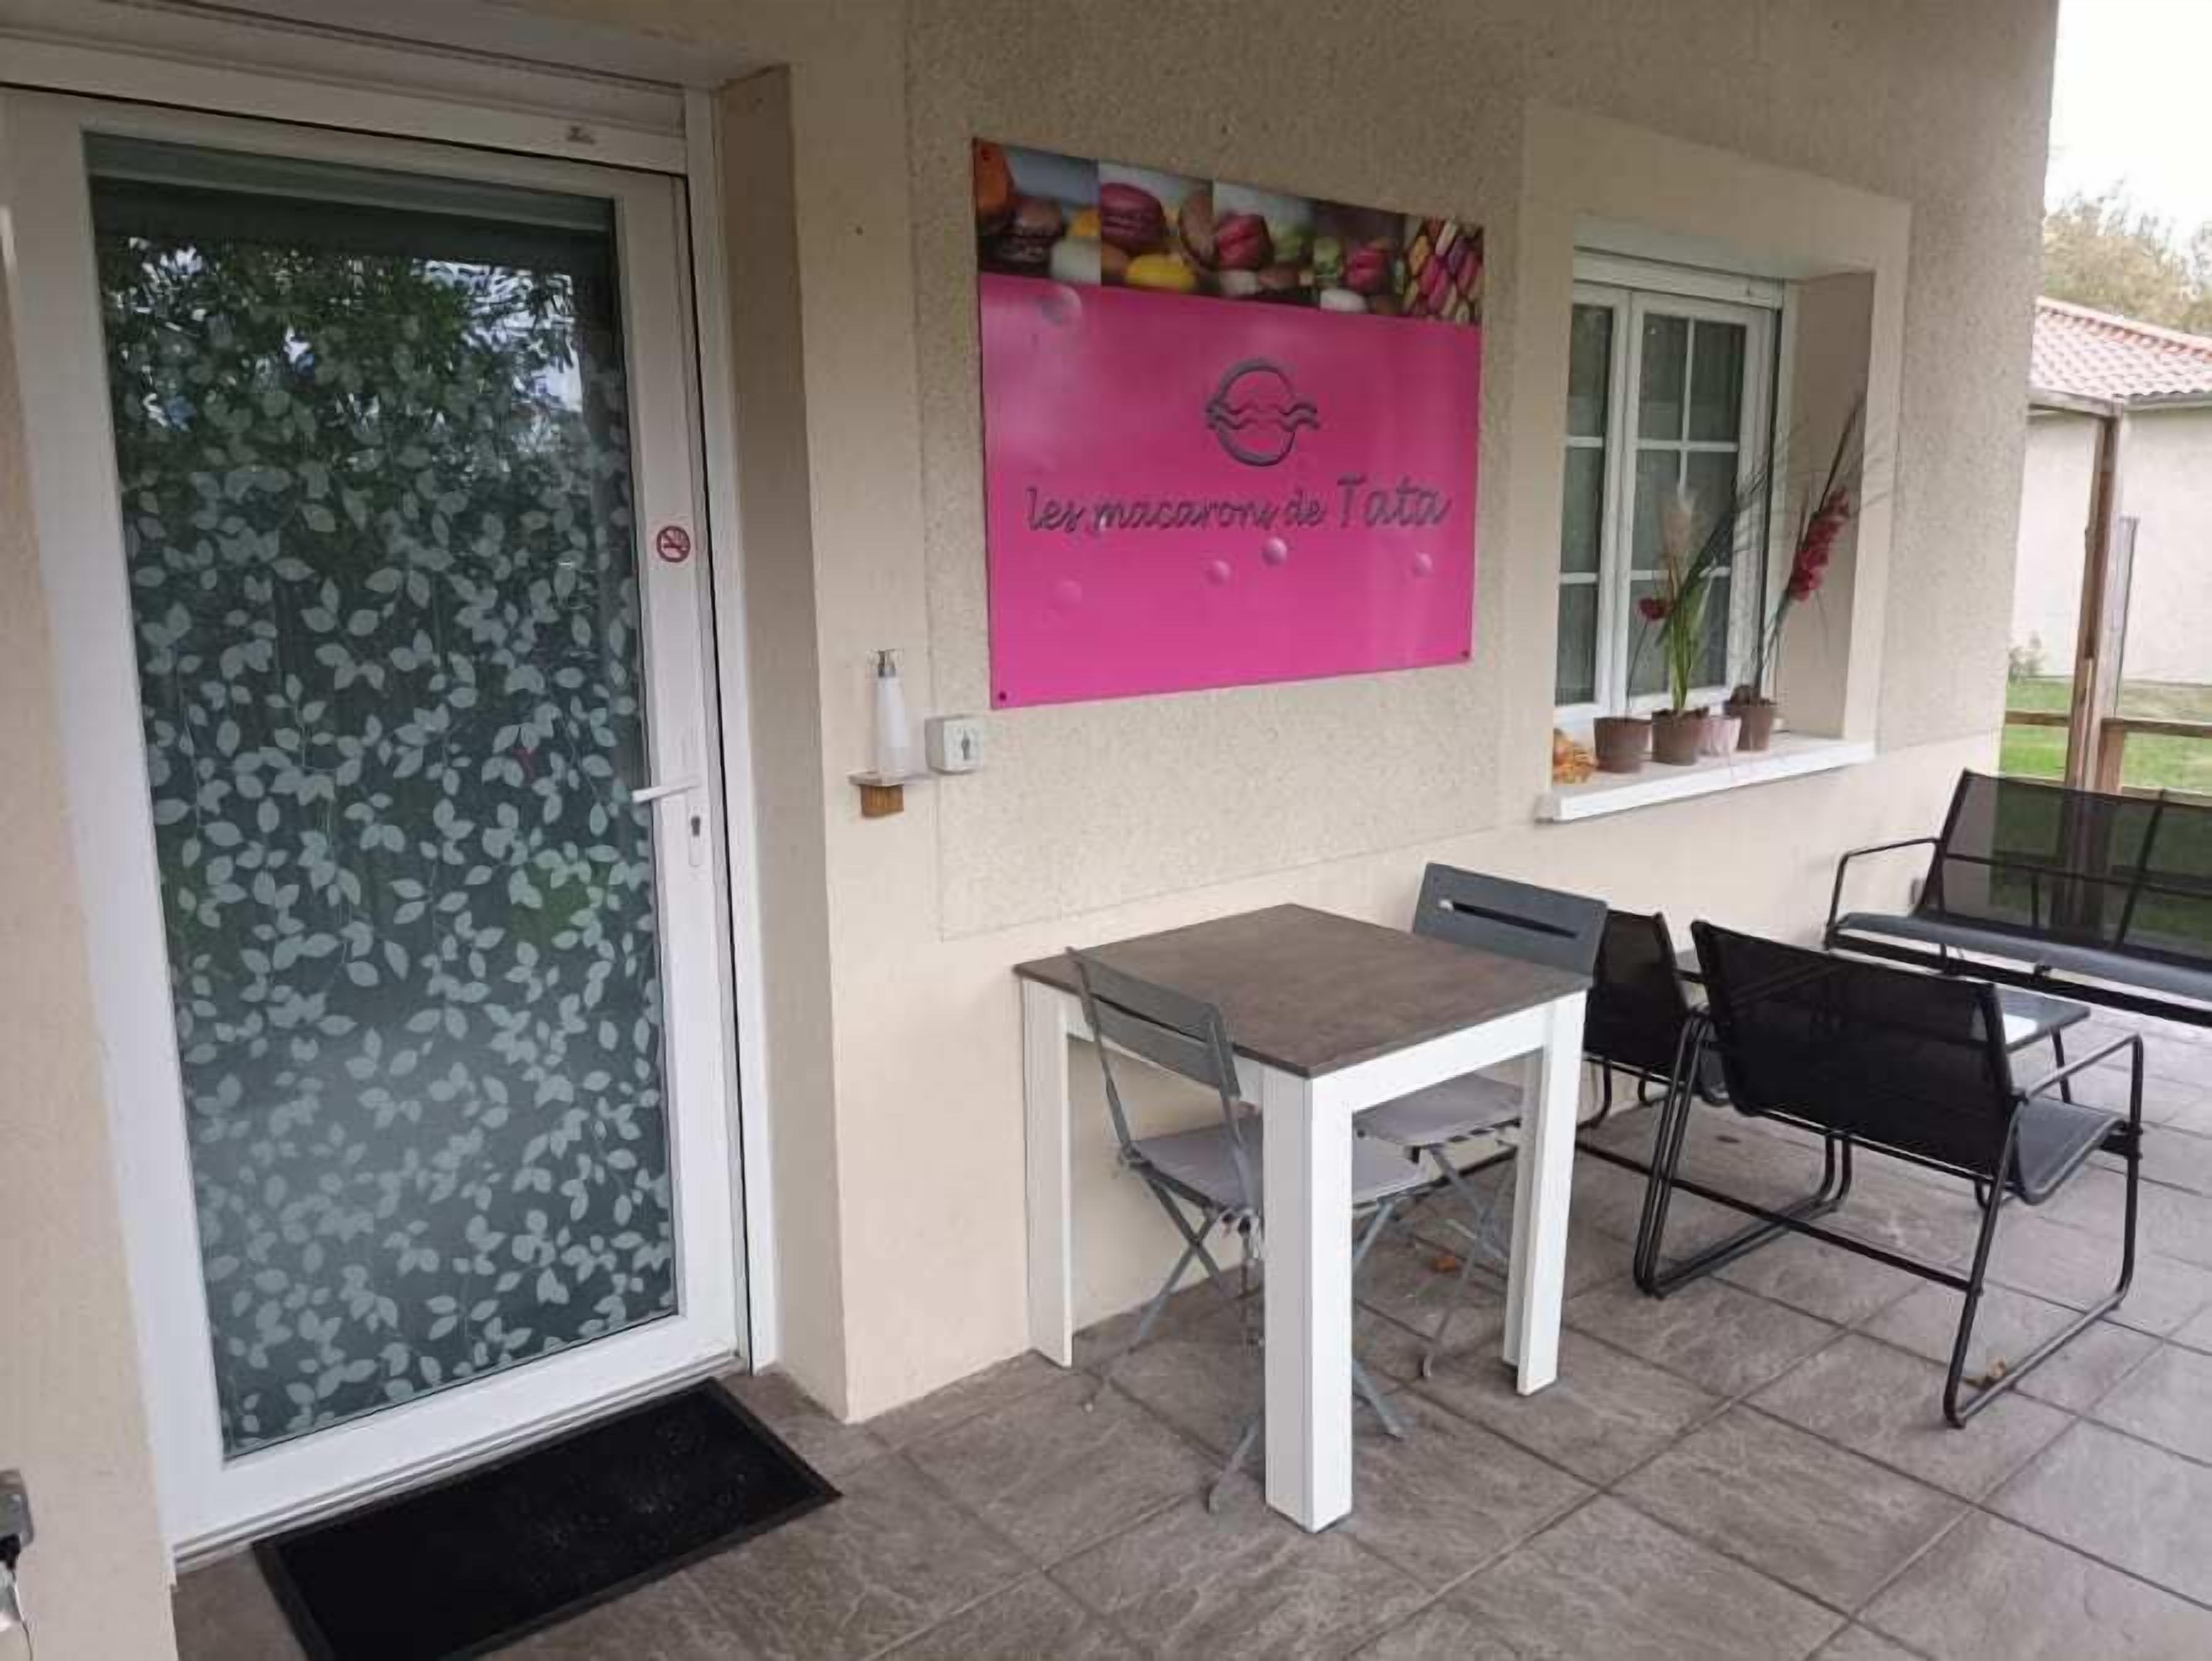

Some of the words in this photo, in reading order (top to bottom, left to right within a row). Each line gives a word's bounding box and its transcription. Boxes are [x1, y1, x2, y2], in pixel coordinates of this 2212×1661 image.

[1093, 499, 1280, 534] macarons
[1284, 489, 1327, 528] de
[1336, 474, 1454, 529] Tata
